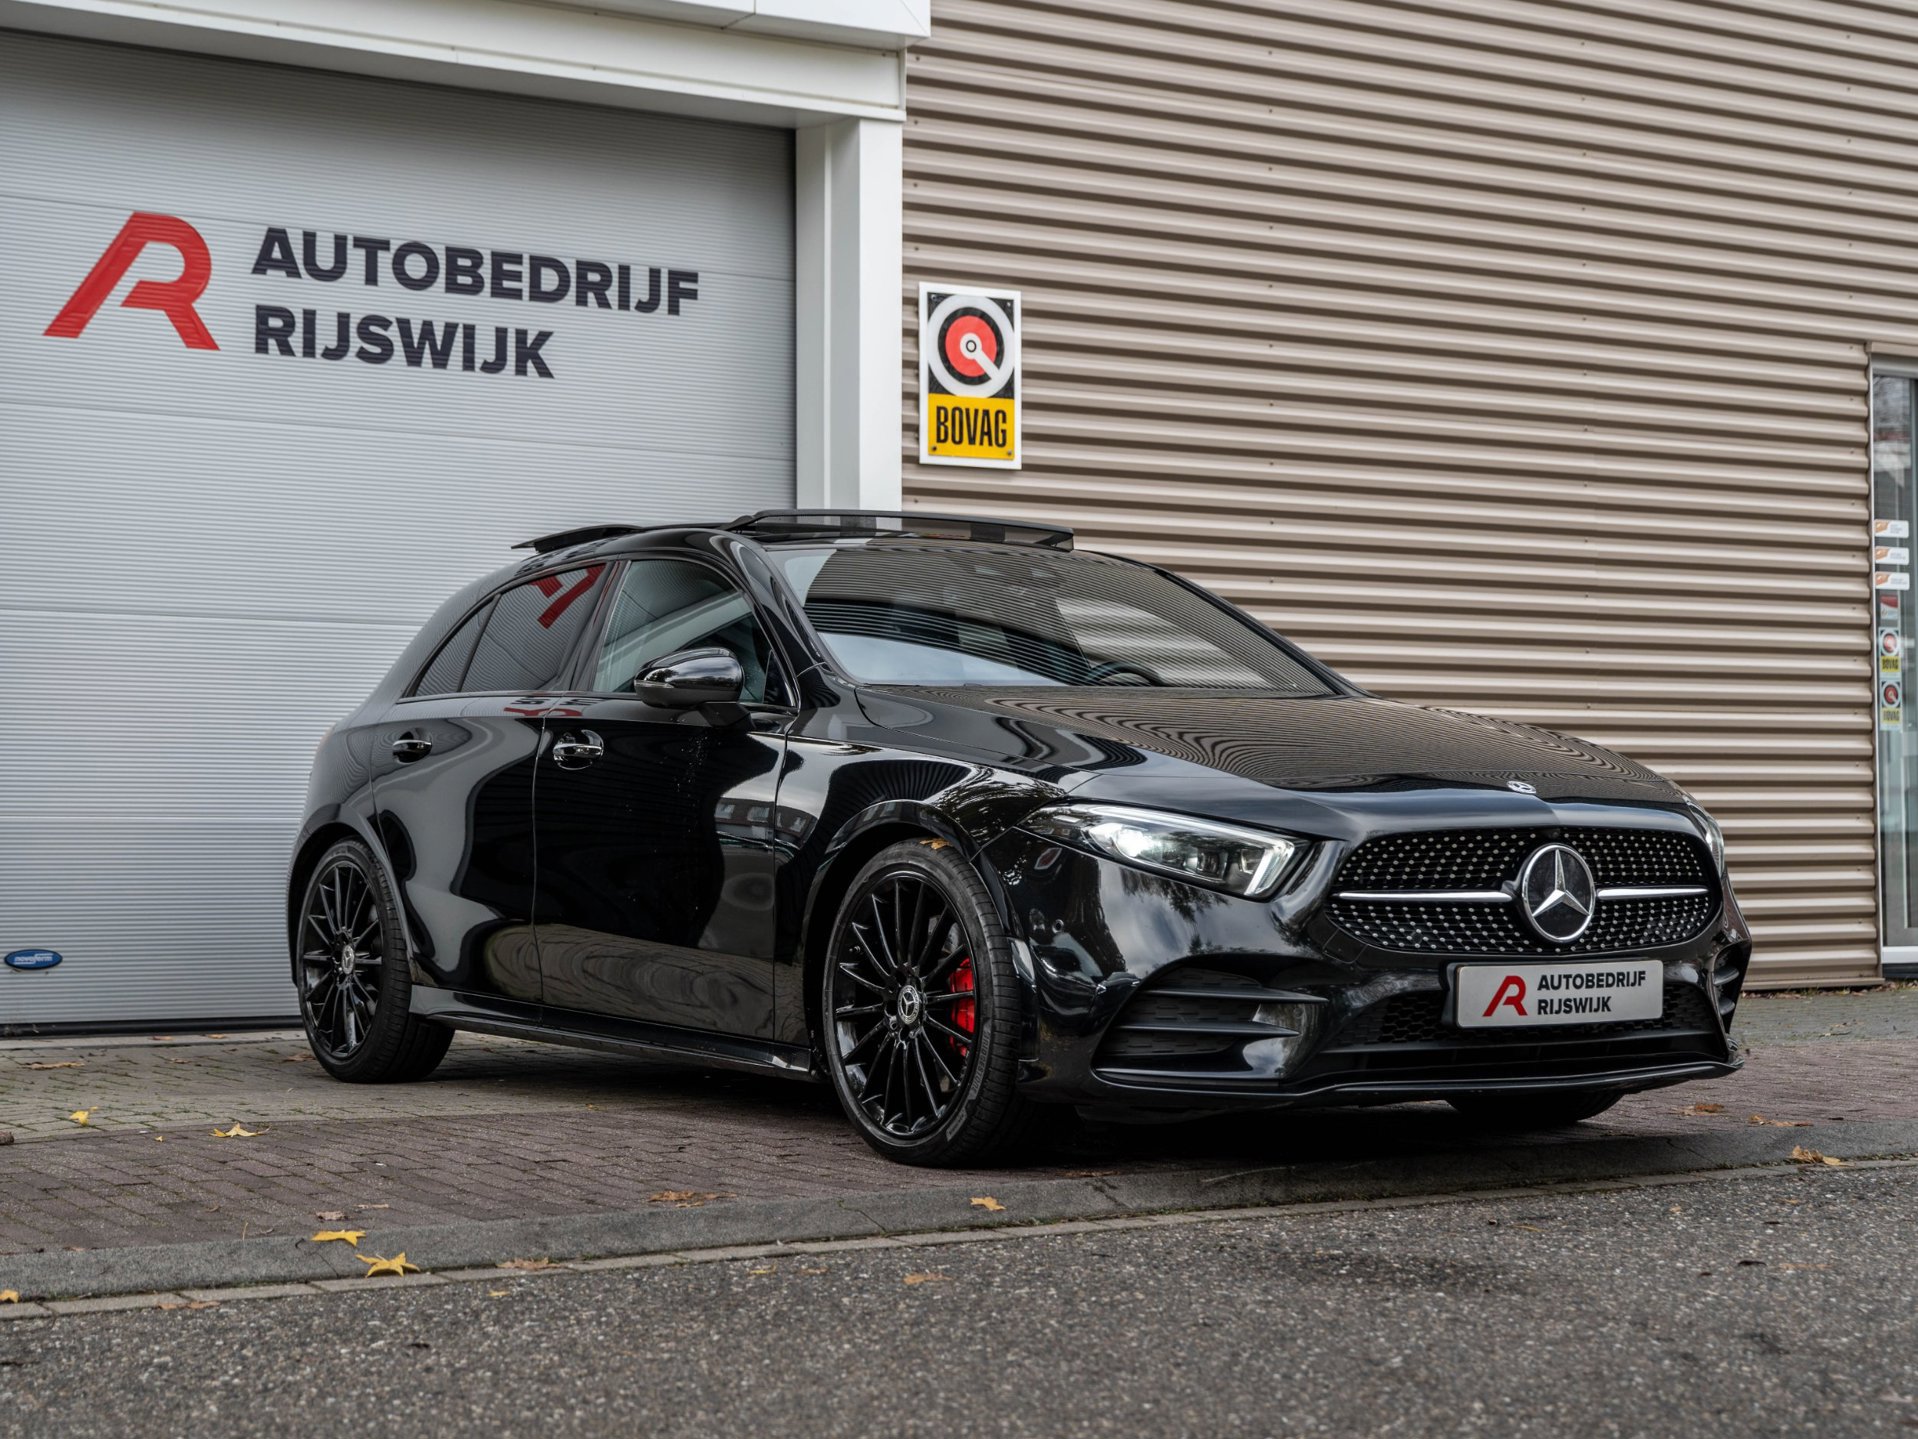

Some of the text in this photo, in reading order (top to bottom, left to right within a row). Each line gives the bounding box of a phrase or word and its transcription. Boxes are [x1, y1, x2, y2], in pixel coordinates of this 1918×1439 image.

[251, 227, 699, 316] AUTOBEDRIJF
[254, 304, 555, 379] RIJSWIJK
[936, 405, 1007, 448] BOVAG
[1882, 658, 1899, 670] BOVAG
[1537, 971, 1646, 991] AUTOBEDRIJF
[1537, 996, 1612, 1015] RIJSWIJK
